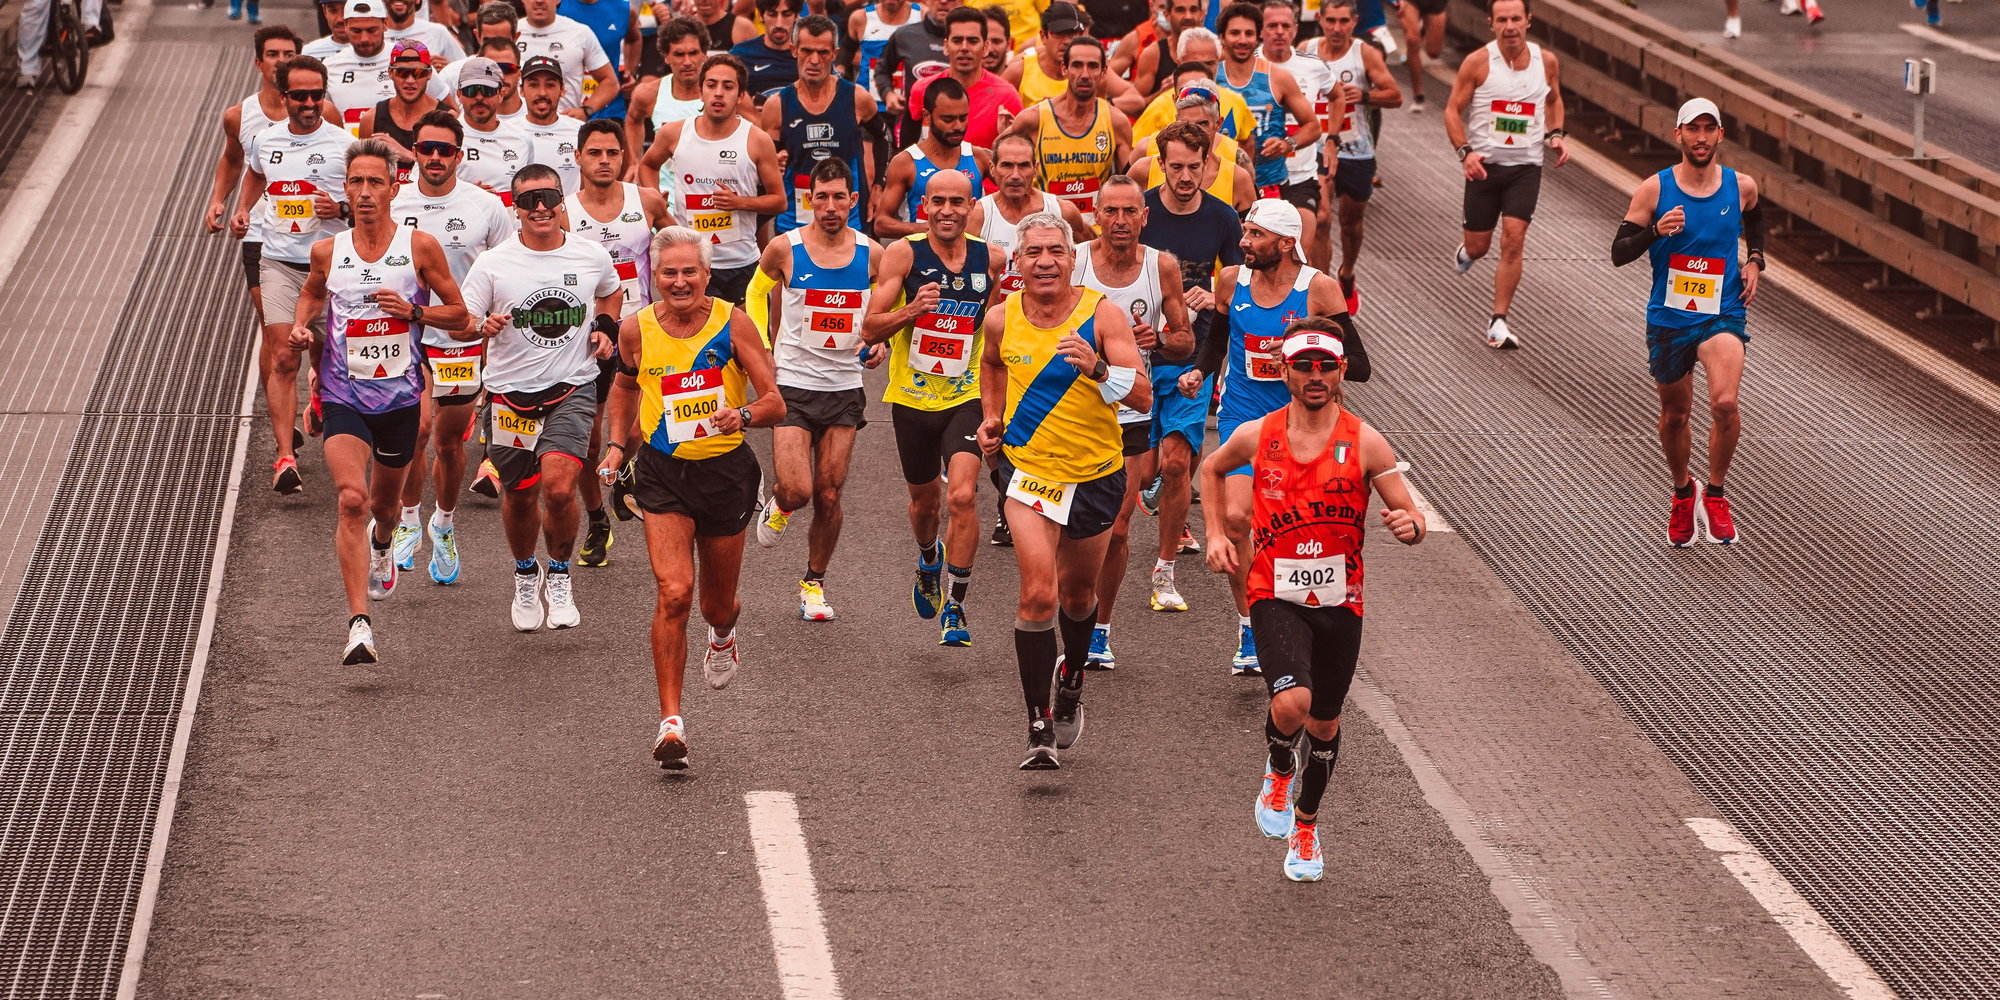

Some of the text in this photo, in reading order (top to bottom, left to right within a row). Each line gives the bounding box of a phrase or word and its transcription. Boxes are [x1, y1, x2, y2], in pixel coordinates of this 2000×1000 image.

[1505, 102, 1523, 115] edp
[1502, 120, 1524, 133] 101
[281, 183, 301, 196] edp
[1065, 181, 1085, 194] edp
[283, 204, 305, 216] 209
[694, 215, 732, 230] 10422
[1686, 257, 1708, 273] edp
[1683, 280, 1706, 295] 178
[525, 289, 575, 308] DIRECTIVO
[824, 291, 847, 308] edp
[366, 319, 390, 335] edp
[820, 317, 846, 330] 456
[935, 316, 957, 333] edp
[530, 333, 572, 347] ULTRAS
[359, 343, 401, 360] 4318
[927, 341, 955, 356] 255
[437, 367, 474, 380] 10421
[681, 371, 706, 390] edp
[674, 399, 718, 420] 10400
[498, 415, 536, 433] 10416
[1020, 479, 1063, 502] 10410
[1270, 505, 1303, 530] dei
[1296, 538, 1324, 559] edp
[1288, 567, 1335, 586] 4902
